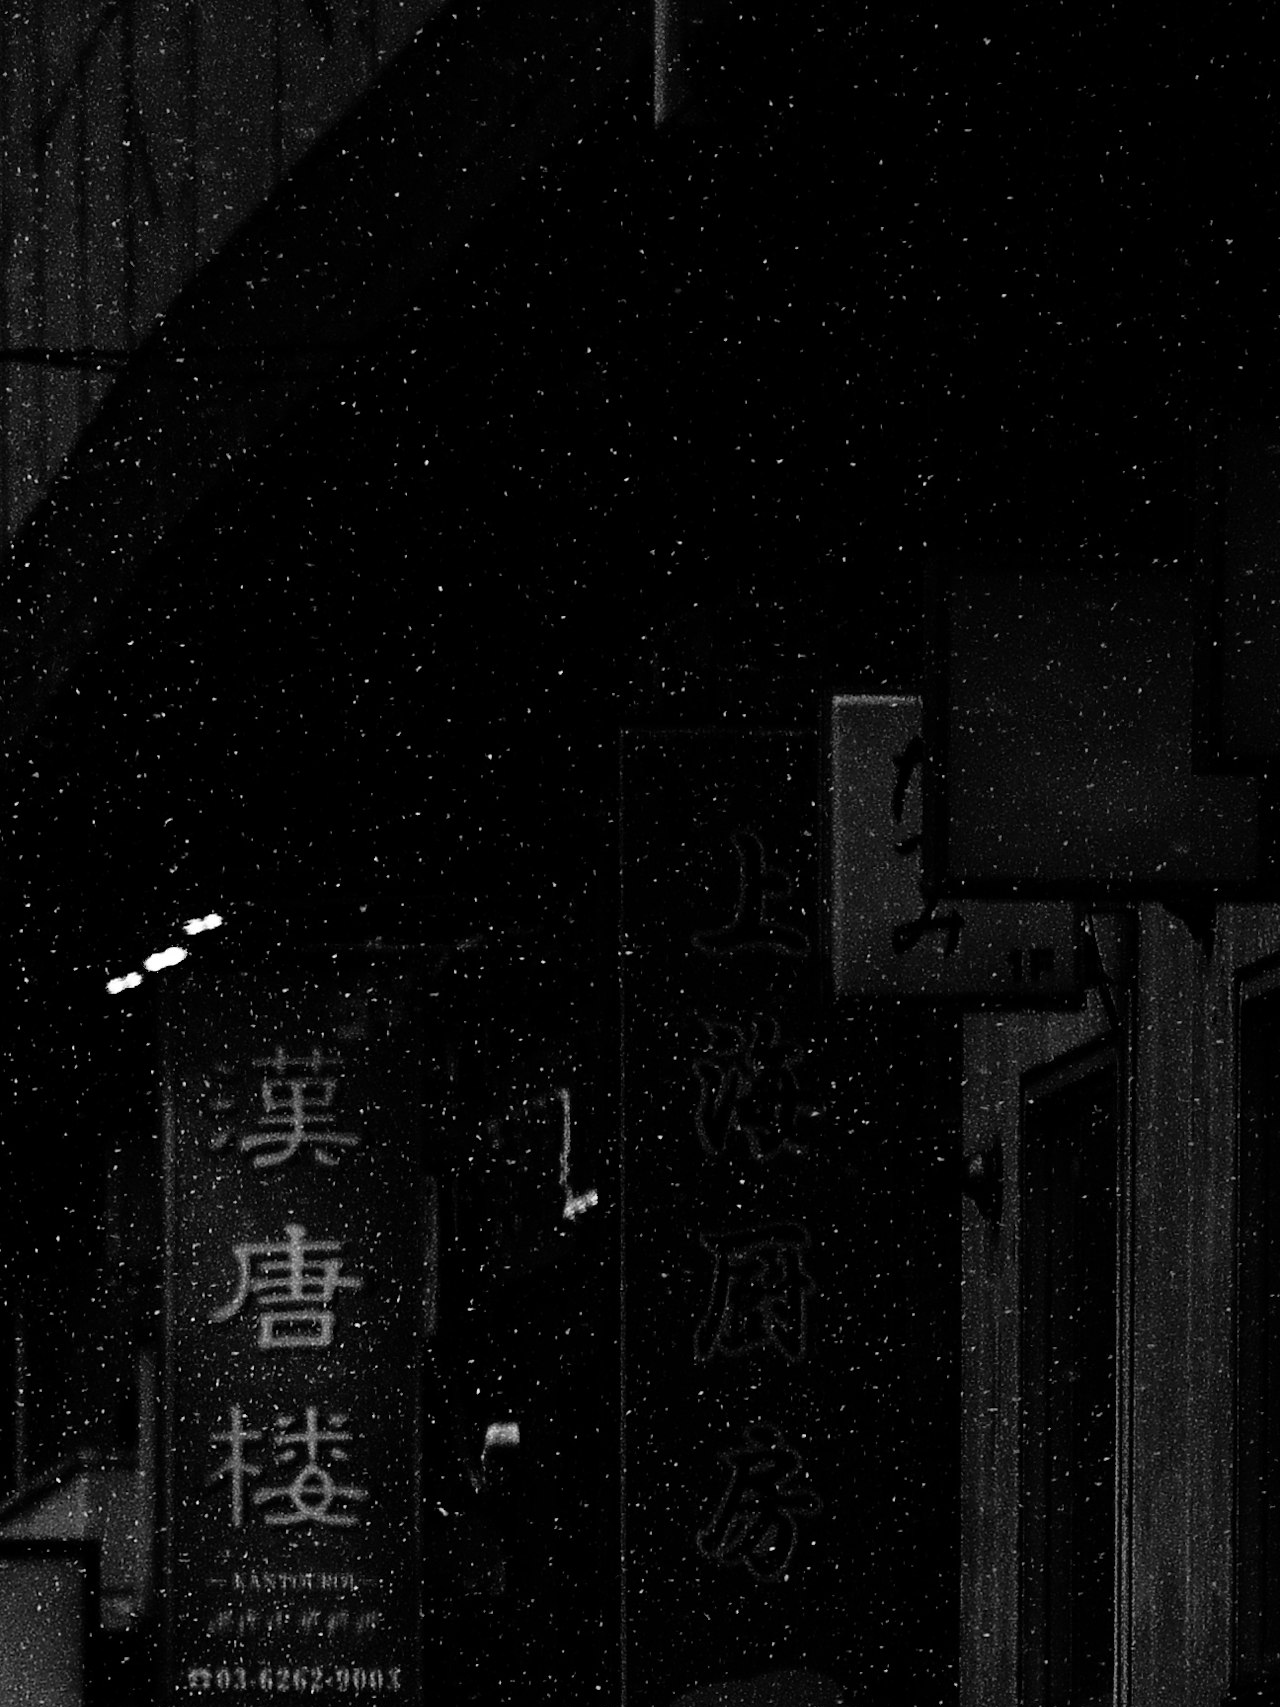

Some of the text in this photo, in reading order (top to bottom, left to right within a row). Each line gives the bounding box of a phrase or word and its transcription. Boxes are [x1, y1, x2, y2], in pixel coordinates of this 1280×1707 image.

[689, 828, 825, 1584] 上海厨房
[1006, 948, 1055, 982] 1F
[206, 1046, 368, 1530] 漢唐楼
